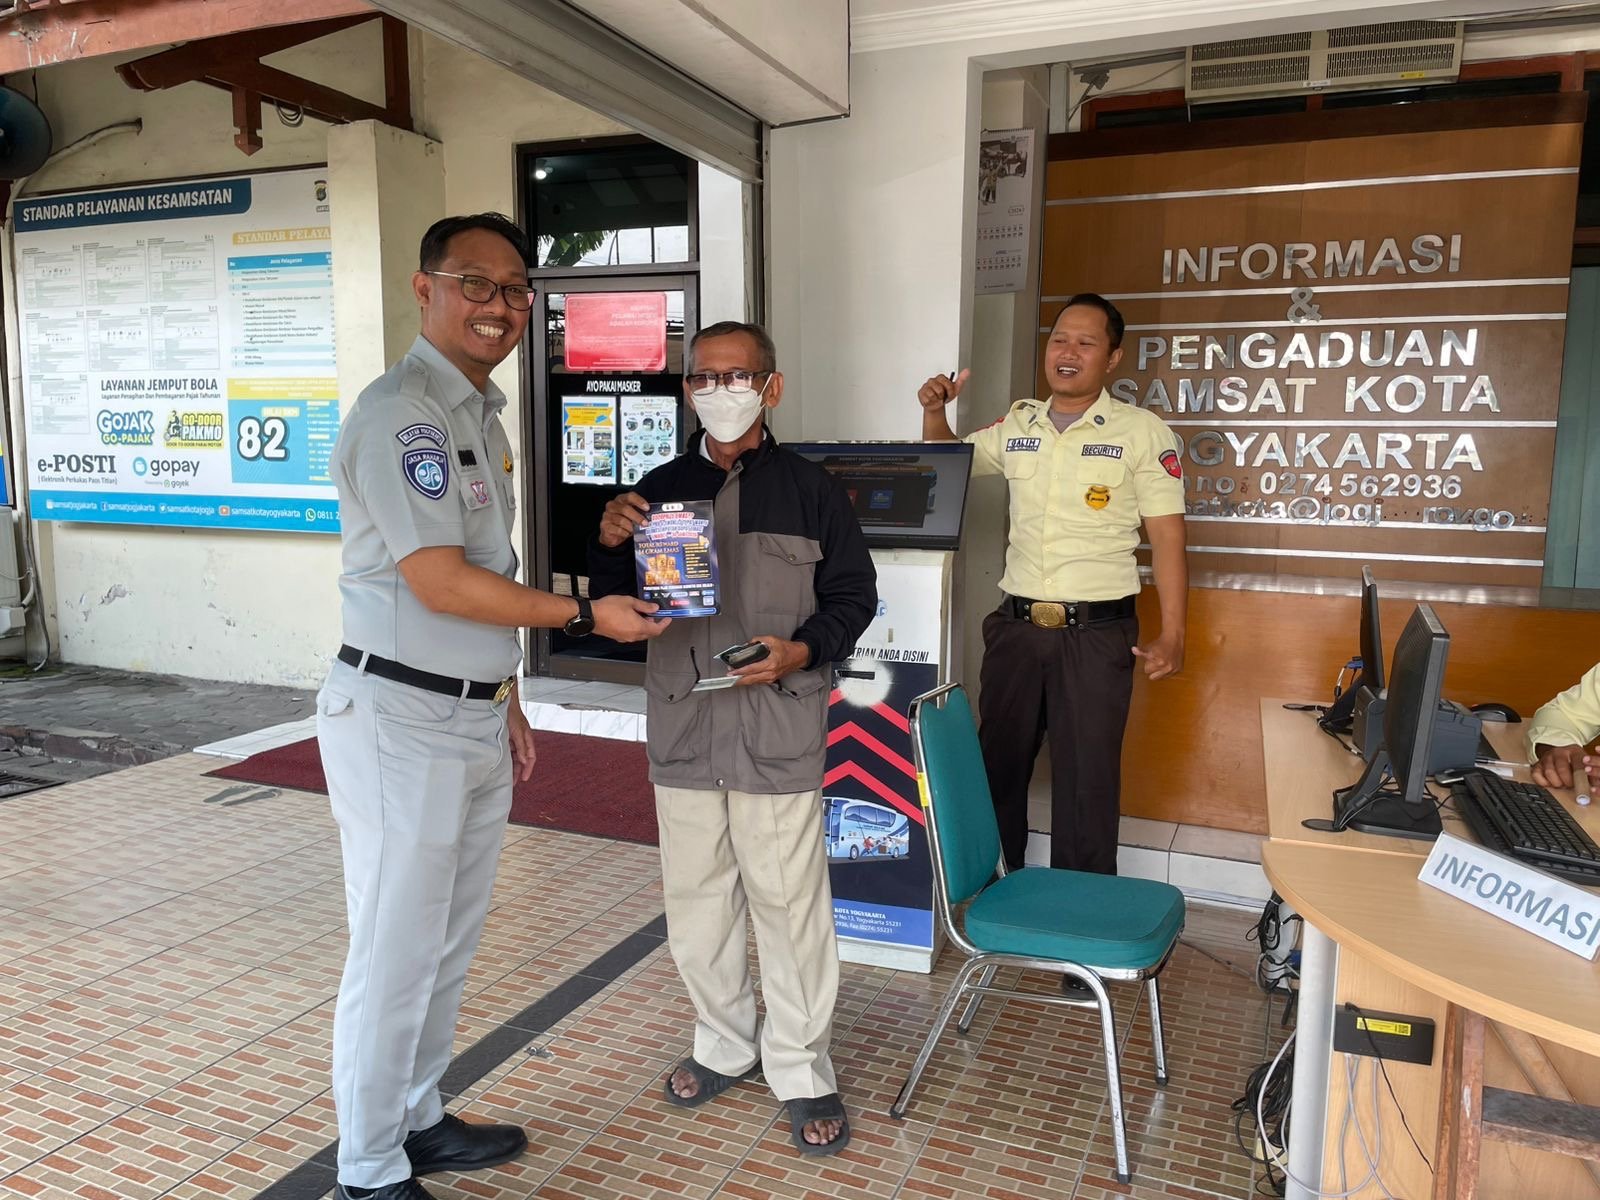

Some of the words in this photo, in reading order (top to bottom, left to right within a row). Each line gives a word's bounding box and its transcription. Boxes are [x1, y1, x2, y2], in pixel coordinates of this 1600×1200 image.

[23, 203, 75, 222] STANDAR
[77, 195, 145, 217] PELAYANAN
[148, 188, 233, 210] KESAMSATAN
[238, 231, 286, 244] STANDAR
[1161, 233, 1463, 285] INFORMASI
[1286, 286, 1323, 324] &
[1137, 327, 1478, 371] PENGADUAN
[101, 379, 145, 391] LAYANAN
[147, 378, 188, 391] JEMPUT
[190, 378, 218, 391] BOLA
[586, 380, 599, 393] AYO
[599, 380, 617, 393] PAKAI
[617, 380, 641, 393] MASKER
[1111, 374, 1318, 414] SAMSAT
[1343, 374, 1501, 414] KOTA
[97, 409, 154, 434] GOJAK
[182, 413, 222, 426] GO-DOOR
[102, 433, 153, 445] GO-PAJAK
[182, 425, 223, 441] PAKMO
[237, 416, 289, 462] 82
[1084, 446, 1121, 457] SECURITY
[37, 454, 117, 473] e-POSTI
[150, 459, 200, 476] gopay
[171, 479, 189, 488] gojek
[316, 511, 333, 520] 0811
[877, 648, 900, 661] ANDA
[902, 650, 929, 662] DISINI
[1433, 853, 1600, 946] INFORMASI
[834, 907, 850, 915] KOTA
[850, 908, 886, 919] YOGYAKARTA
[856, 916, 885, 926] Yogyakarta
